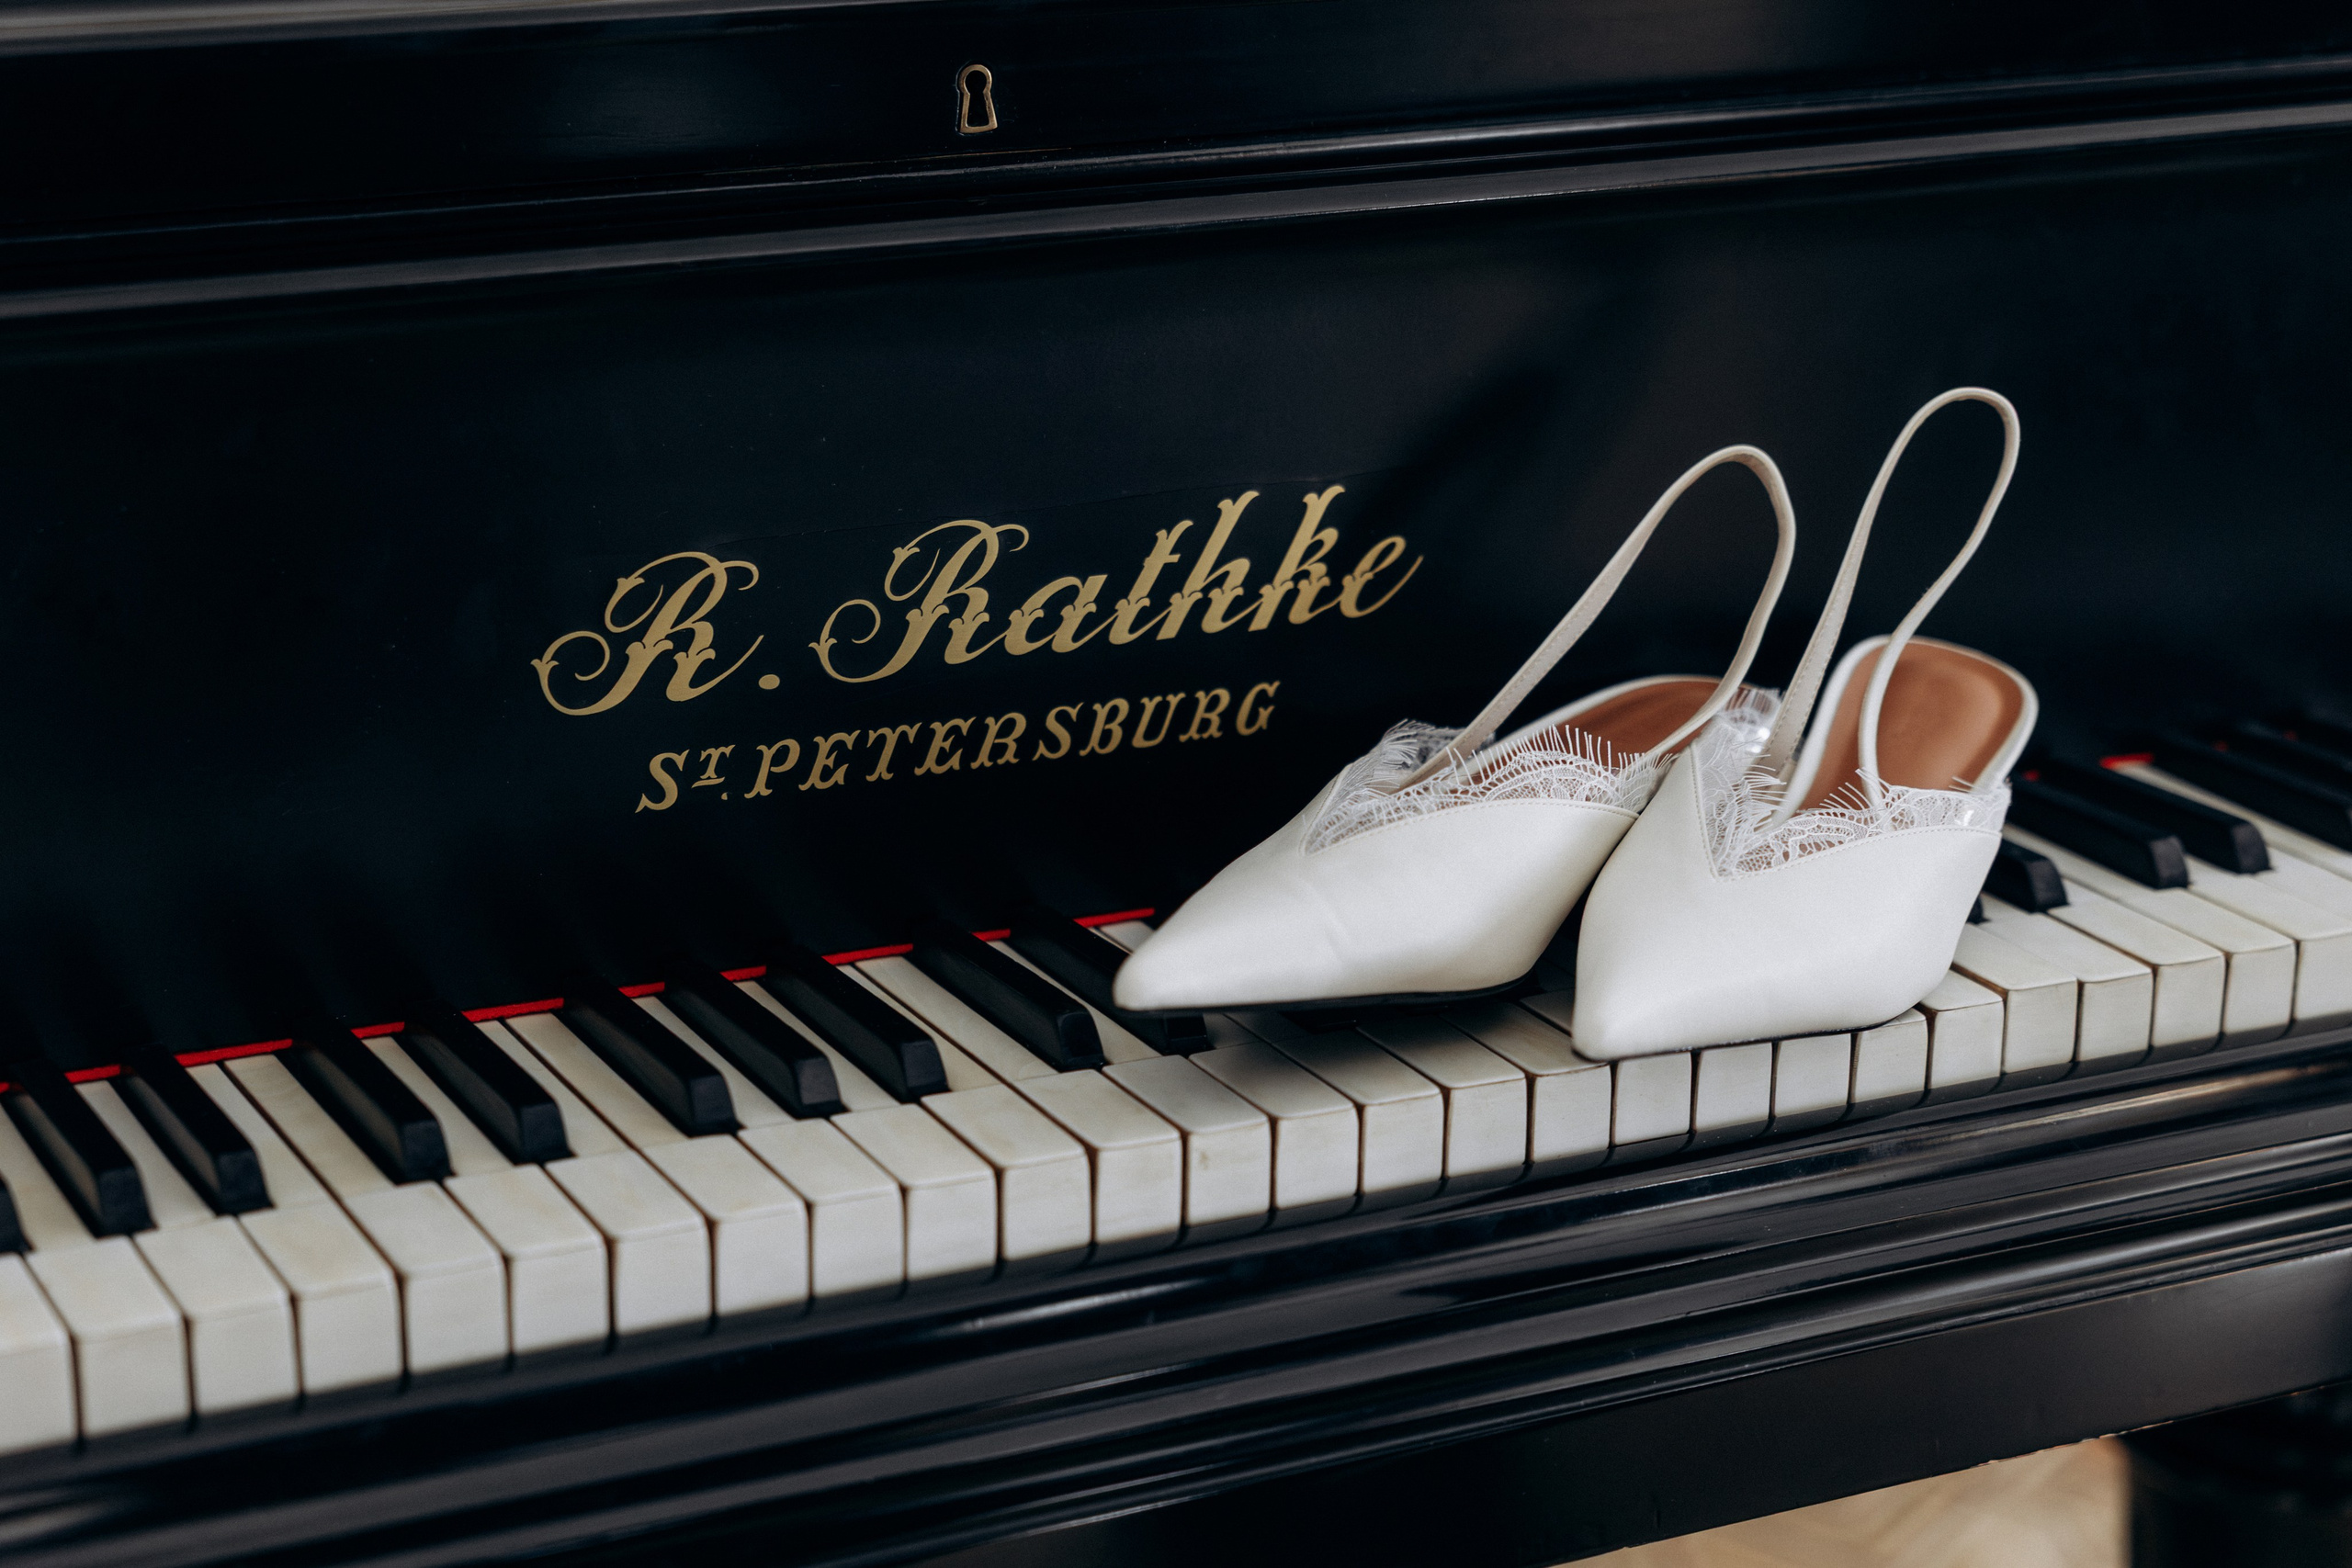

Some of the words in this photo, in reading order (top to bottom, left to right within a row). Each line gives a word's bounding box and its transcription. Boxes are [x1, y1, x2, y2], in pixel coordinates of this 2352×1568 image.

[531, 551, 780, 716] R.
[808, 484, 1423, 683] Rathke
[743, 681, 1280, 799] PETERSBURG
